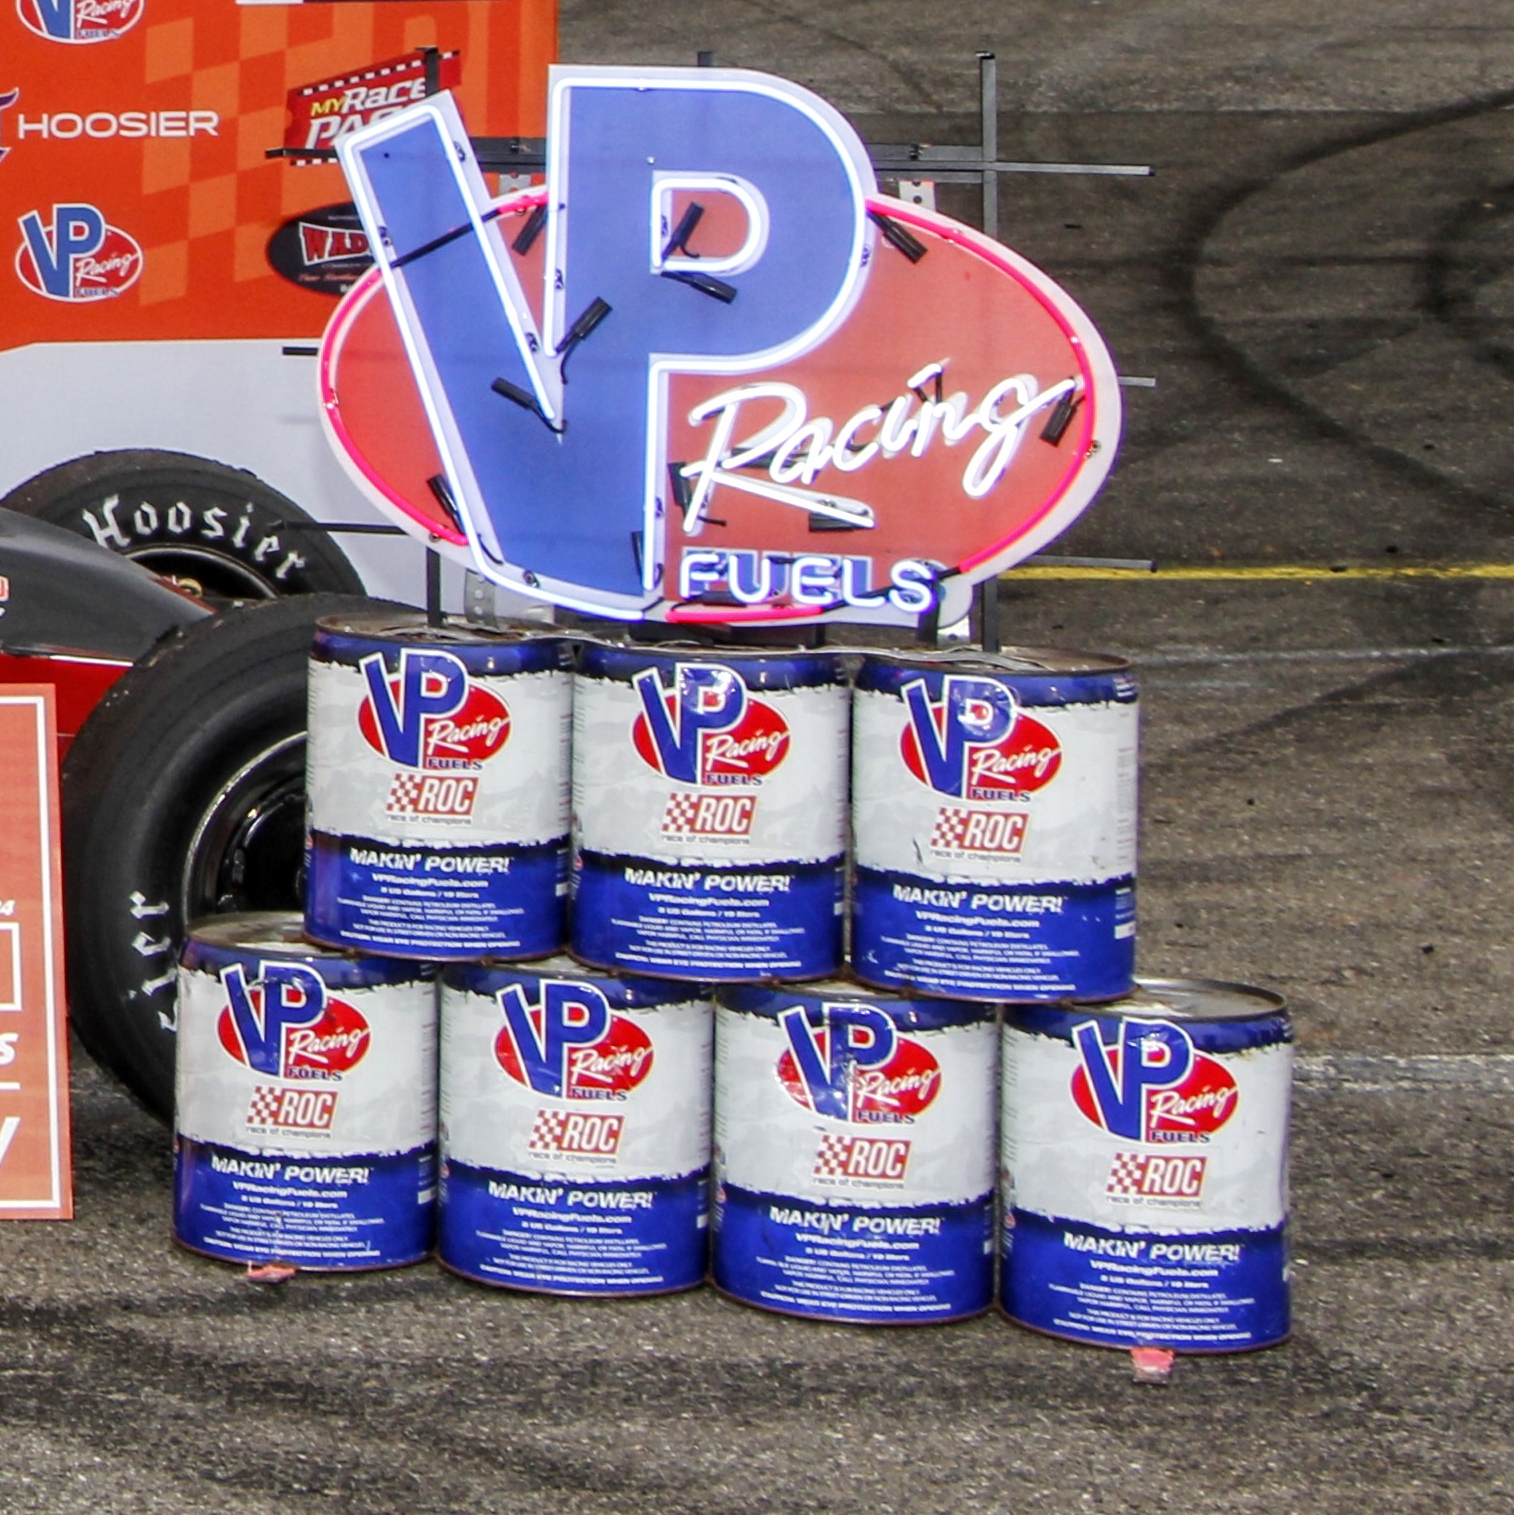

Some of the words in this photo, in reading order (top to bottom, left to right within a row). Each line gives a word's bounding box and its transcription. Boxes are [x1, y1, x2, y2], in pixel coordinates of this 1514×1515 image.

[334, 65, 879, 621] VP
[680, 361, 1082, 535] Racing
[82, 493, 307, 580] Hoosier
[679, 550, 940, 613] FUELS
[359, 648, 470, 769] VP
[427, 715, 512, 754] Racing
[428, 757, 483, 770] FUELS
[418, 777, 474, 813] ROC
[350, 848, 423, 871] MAKIN'
[425, 855, 511, 874] POWER!
[1072, 1017, 1194, 1142] VP
[1143, 1158, 1203, 1194] ROC
[1064, 1232, 1145, 1259] MAKIN'
[1150, 1242, 1242, 1262] POWER!
